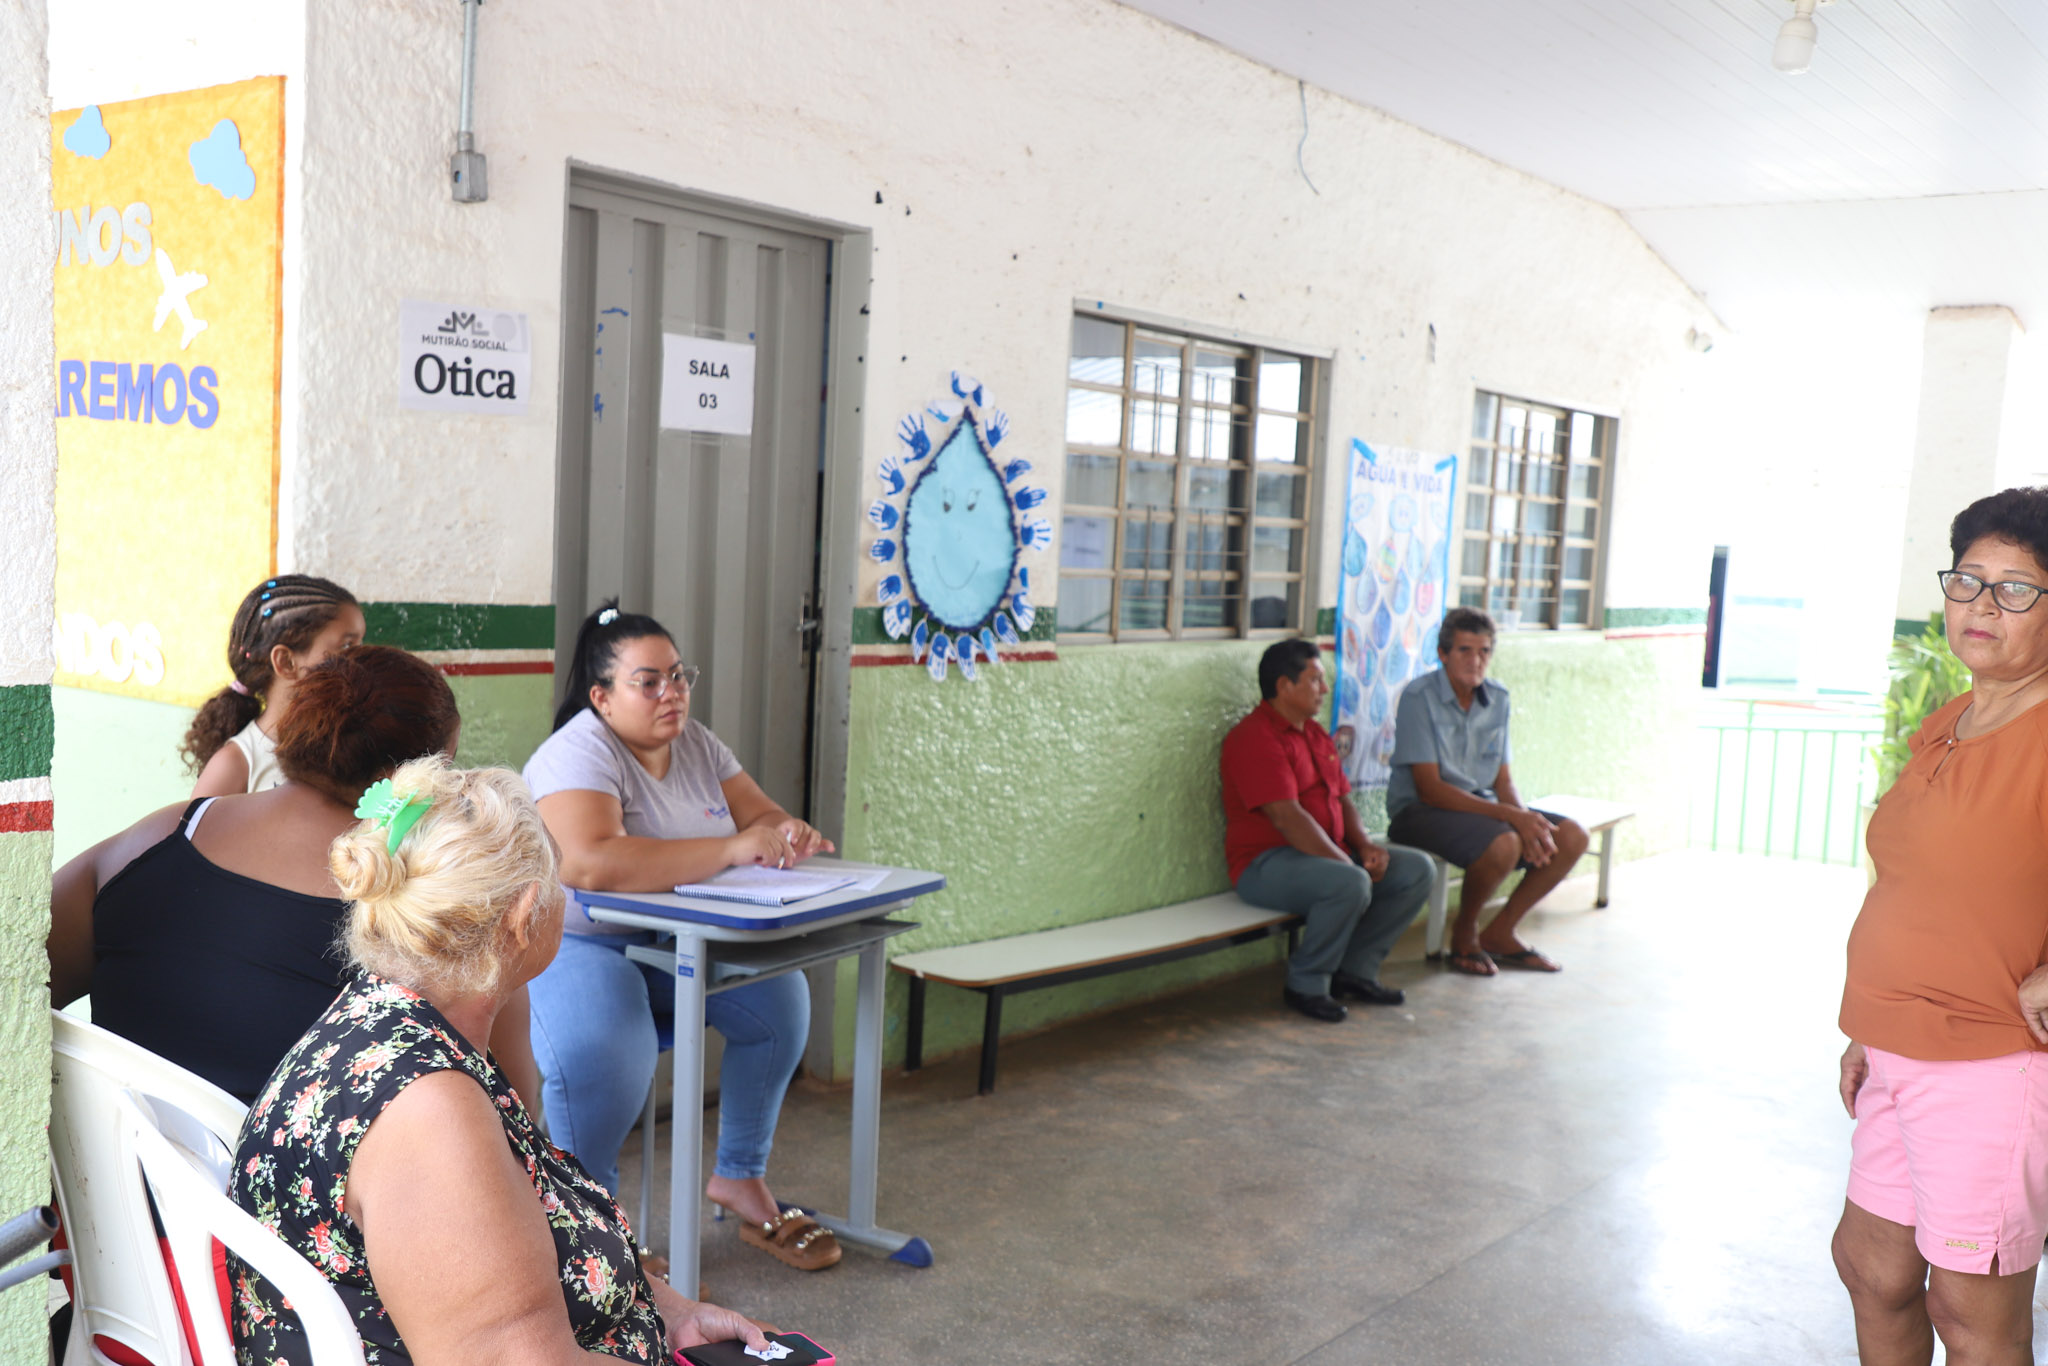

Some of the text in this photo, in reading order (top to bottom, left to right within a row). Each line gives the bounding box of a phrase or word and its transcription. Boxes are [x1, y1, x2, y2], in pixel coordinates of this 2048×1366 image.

[421, 334, 508, 351] MUTIRÃO SOCIAL
[414, 353, 517, 399] Otica
[689, 360, 730, 379] SALA
[55, 360, 219, 429] REMOS
[699, 392, 718, 409] 03
[1414, 472, 1443, 494] VIDA
